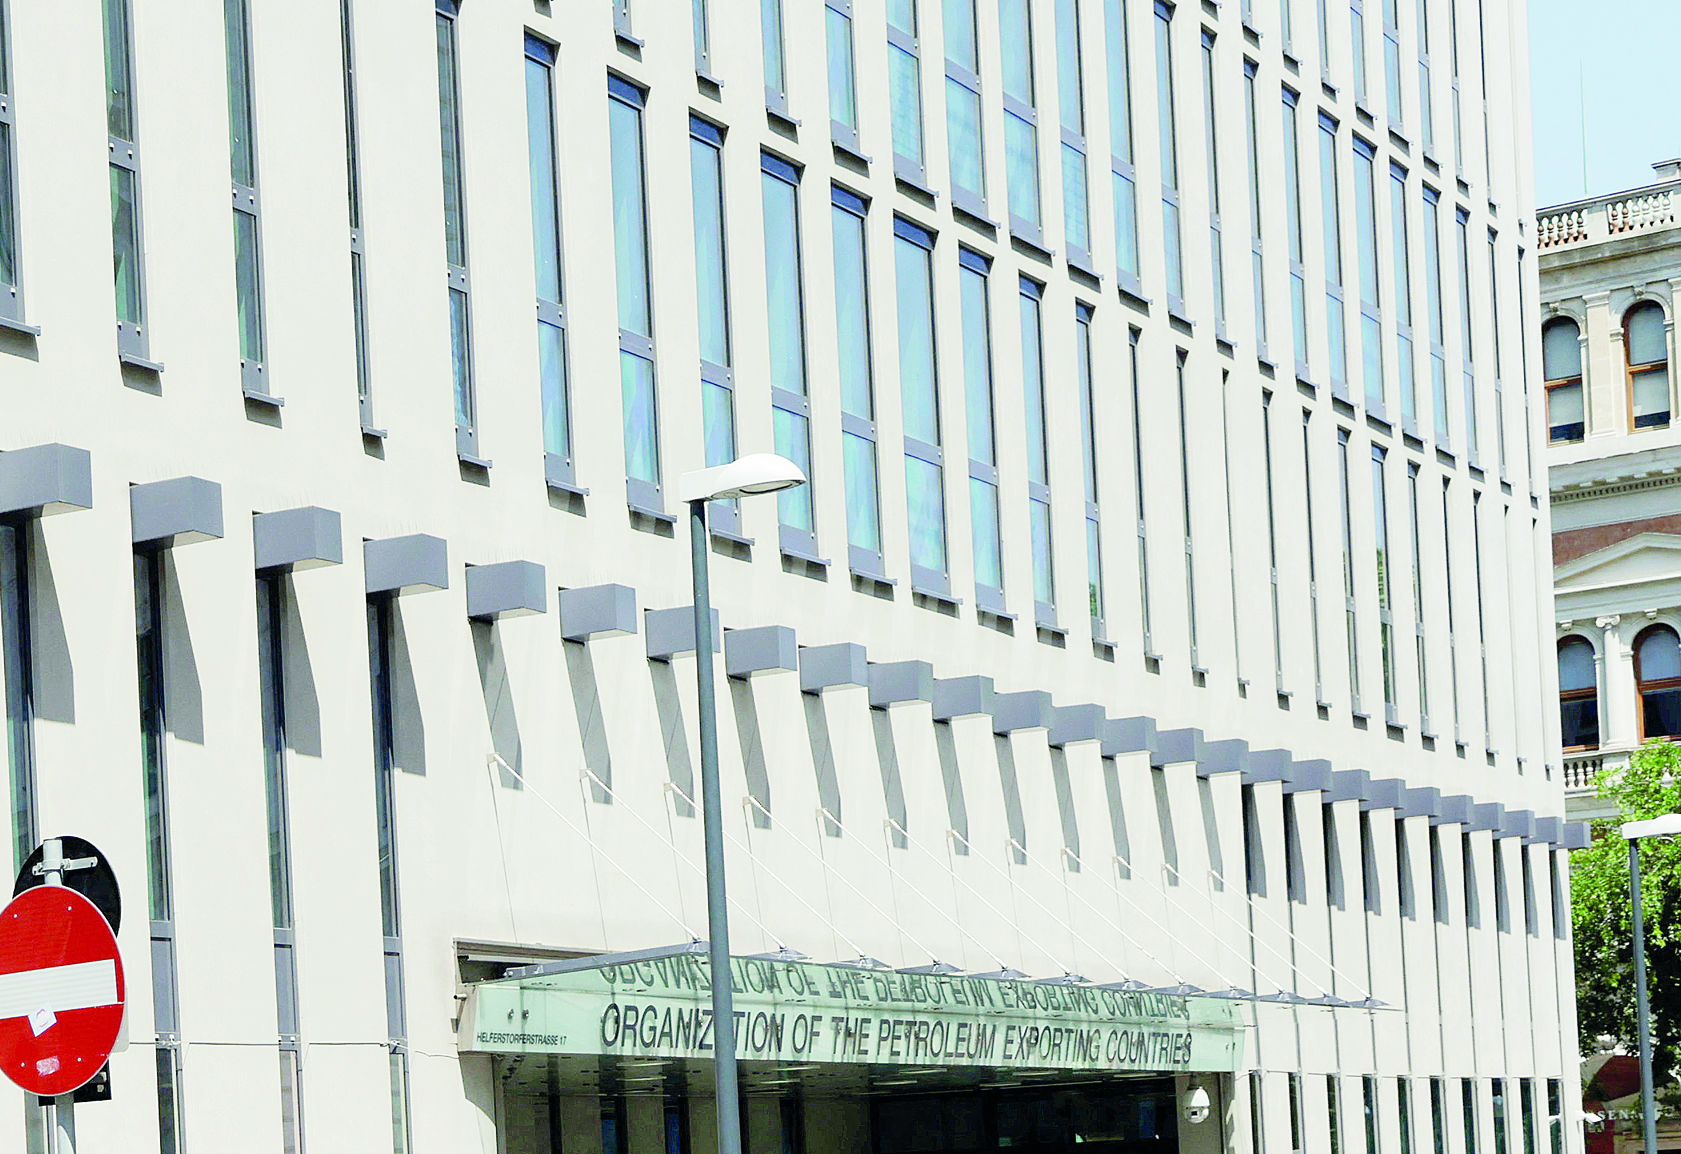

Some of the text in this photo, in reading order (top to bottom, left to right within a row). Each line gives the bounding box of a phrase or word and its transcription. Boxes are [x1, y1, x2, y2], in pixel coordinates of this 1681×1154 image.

[476, 1031, 568, 1046] HELFERSTORFERSTRASSE 17
[601, 1003, 1193, 1065] ORGANIZTION OF THE PETROLEUM EXPORTING COUNTRIES
